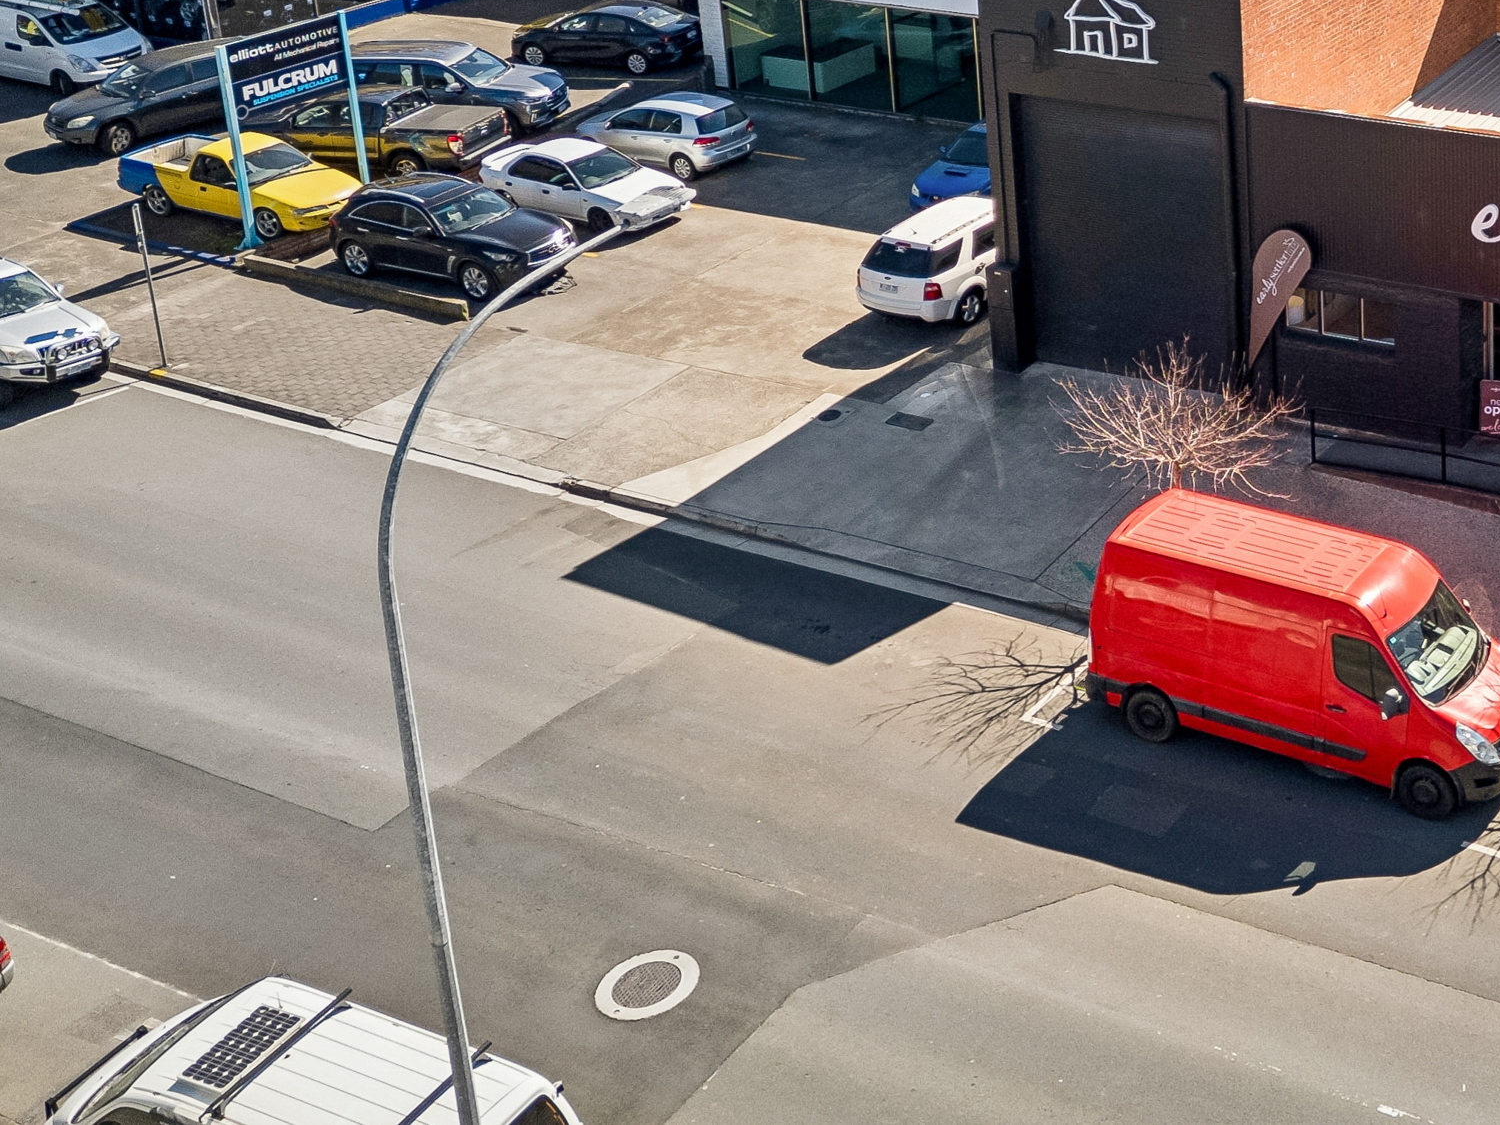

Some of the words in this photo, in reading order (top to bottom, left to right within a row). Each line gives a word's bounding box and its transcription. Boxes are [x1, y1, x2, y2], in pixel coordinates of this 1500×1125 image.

[229, 42, 277, 63] elliott
[274, 25, 339, 50] AUTOMOTIVE
[274, 53, 283, 61] All
[283, 43, 317, 59] Mechanical
[317, 38, 339, 48] Repairs
[242, 59, 338, 101] FULCRUM
[253, 87, 296, 106] SUSPENSION
[297, 74, 339, 92] SPECIALISTS
[1256, 278, 1277, 305] early
